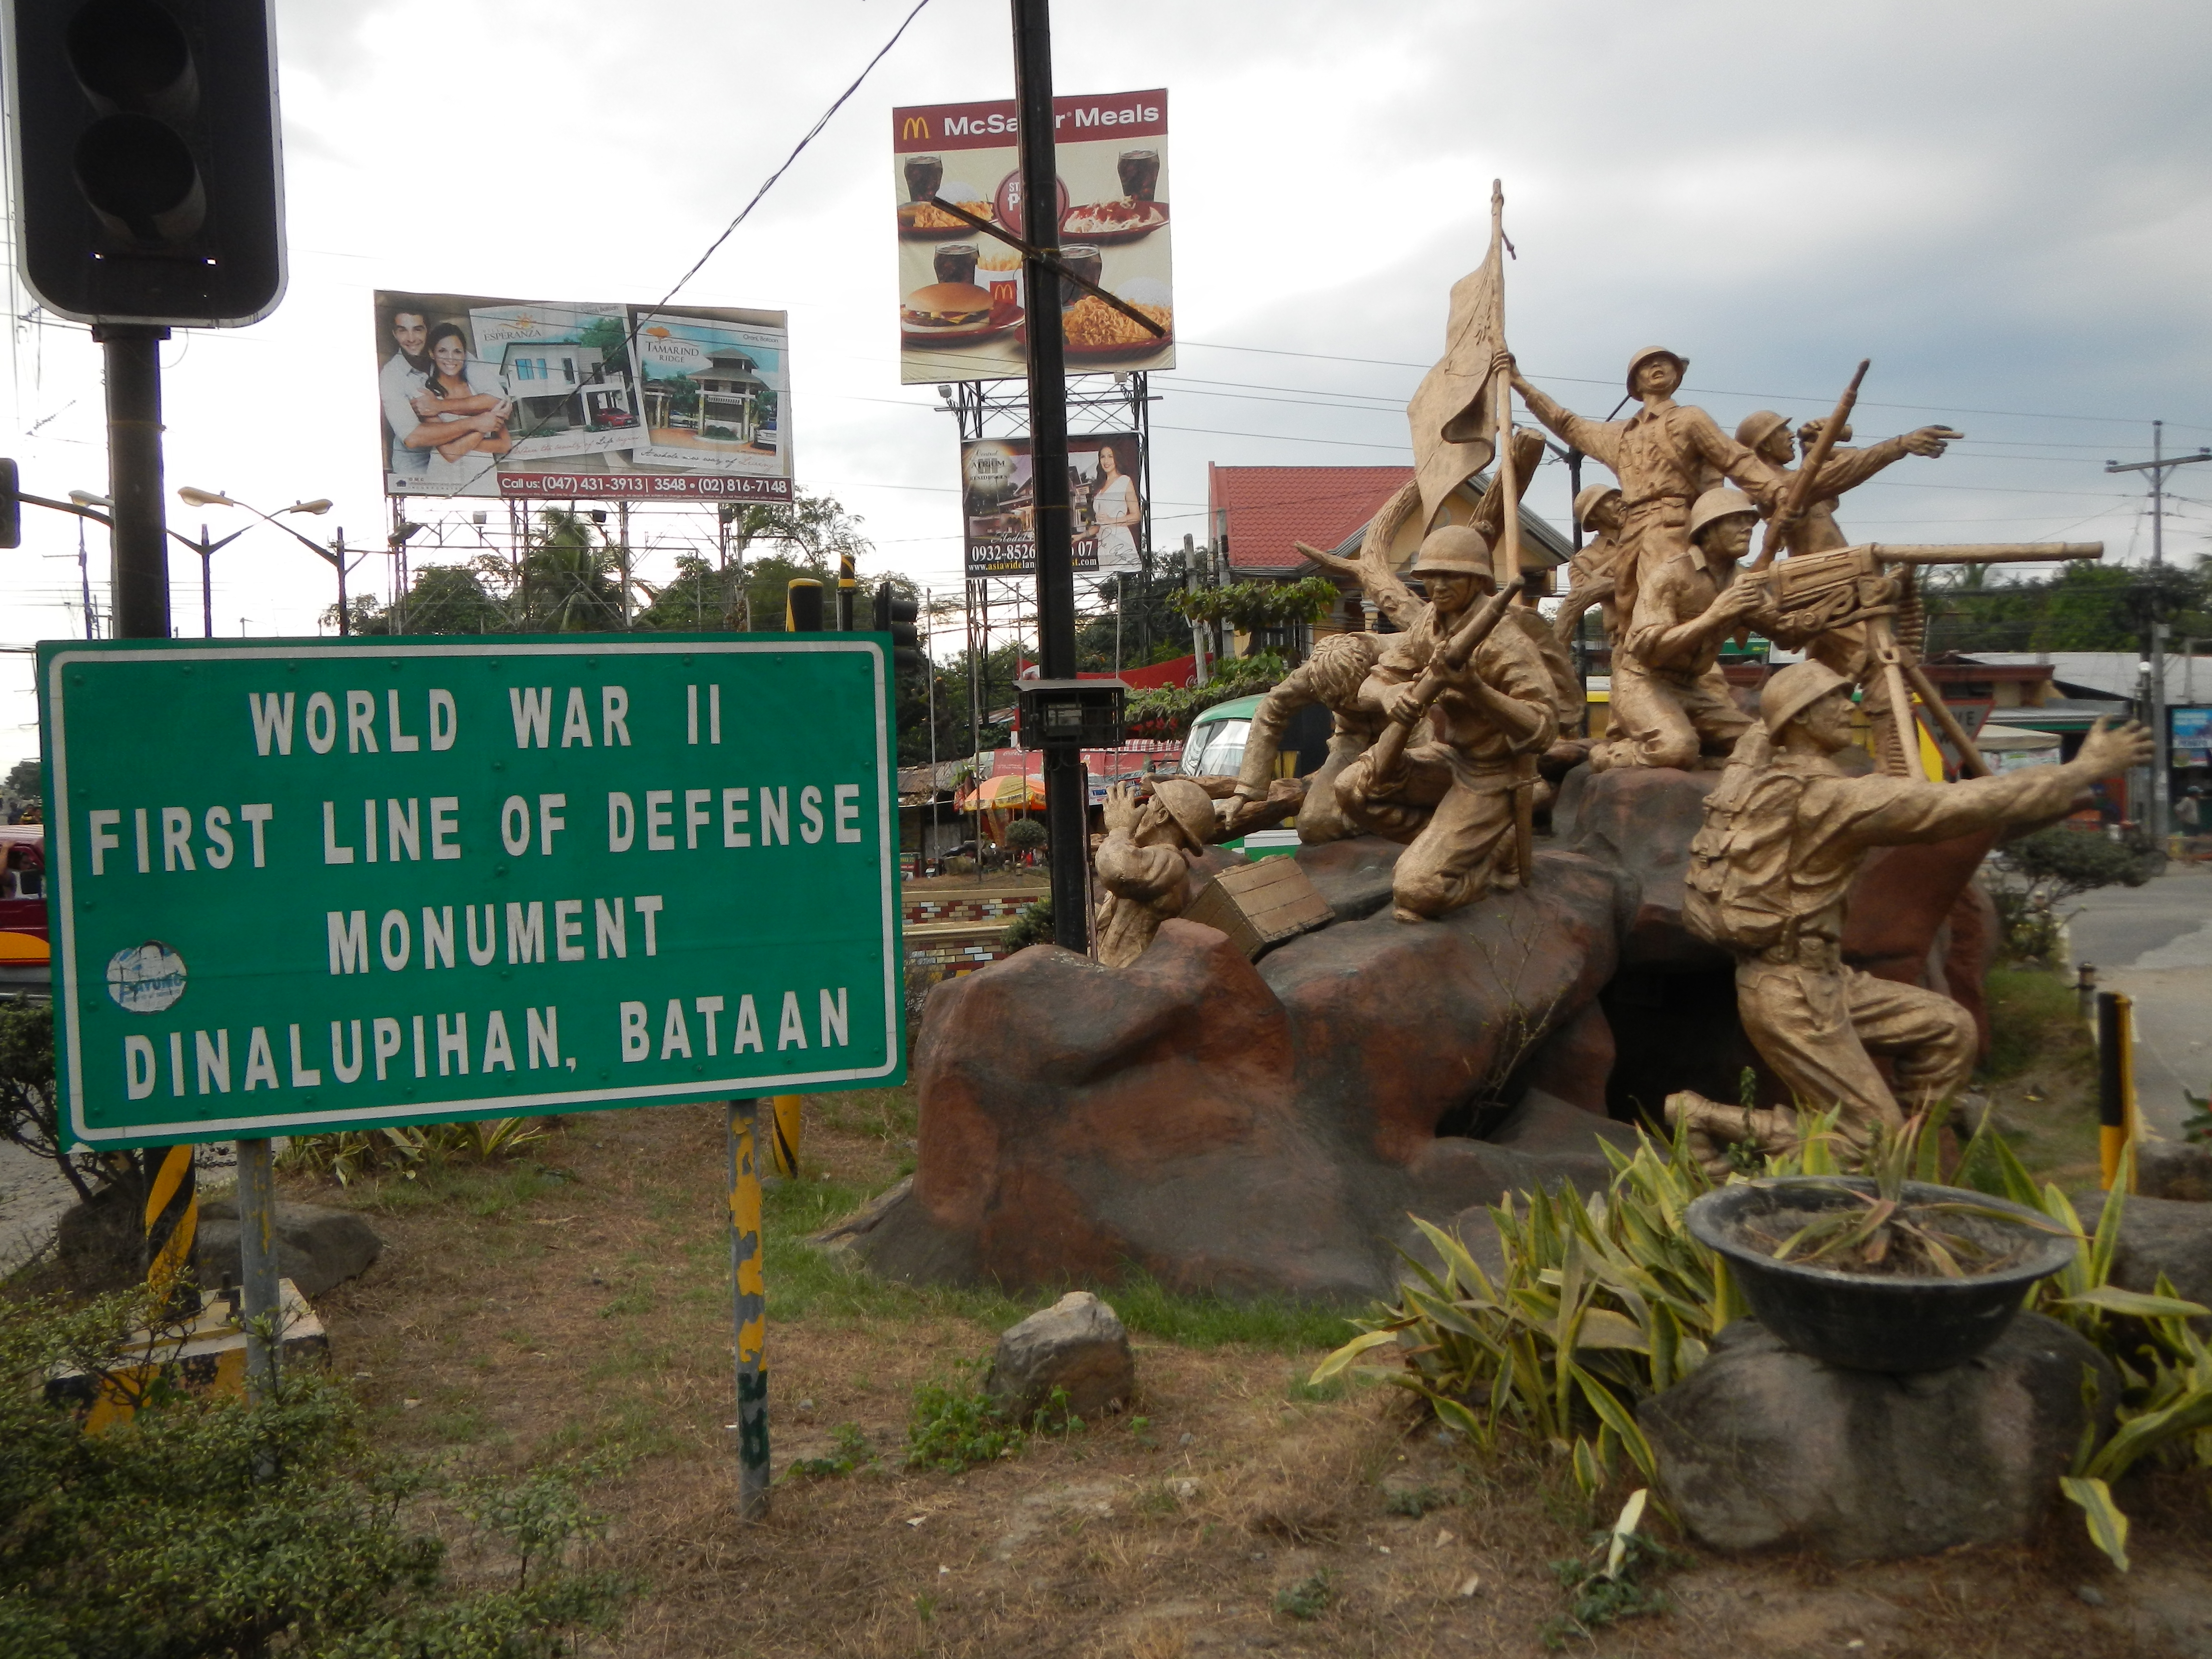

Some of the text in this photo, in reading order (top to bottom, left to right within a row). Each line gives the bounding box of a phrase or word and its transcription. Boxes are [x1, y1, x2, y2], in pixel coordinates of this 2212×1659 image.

[944, 114, 1066, 136] McSar
[1075, 104, 1159, 128] Meals
[483, 330, 541, 341] ESPERANZA
[725, 458, 738, 469] of
[502, 478, 524, 489] Call
[526, 480, 540, 489] us:
[542, 476, 577, 493] (047)
[580, 477, 643, 491] 431-3913
[654, 478, 686, 491] 3548
[698, 478, 724, 494] (02)
[726, 479, 787, 493] 816-7148
[971, 541, 1093, 562] 0932-8526 07
[250, 685, 721, 756] WORLD WAR II
[90, 784, 861, 876] FIRST LINE OF DEFENSE
[327, 895, 663, 975] MONUMENT
[125, 987, 848, 1100] DINALUPIHAN, BATAAN
